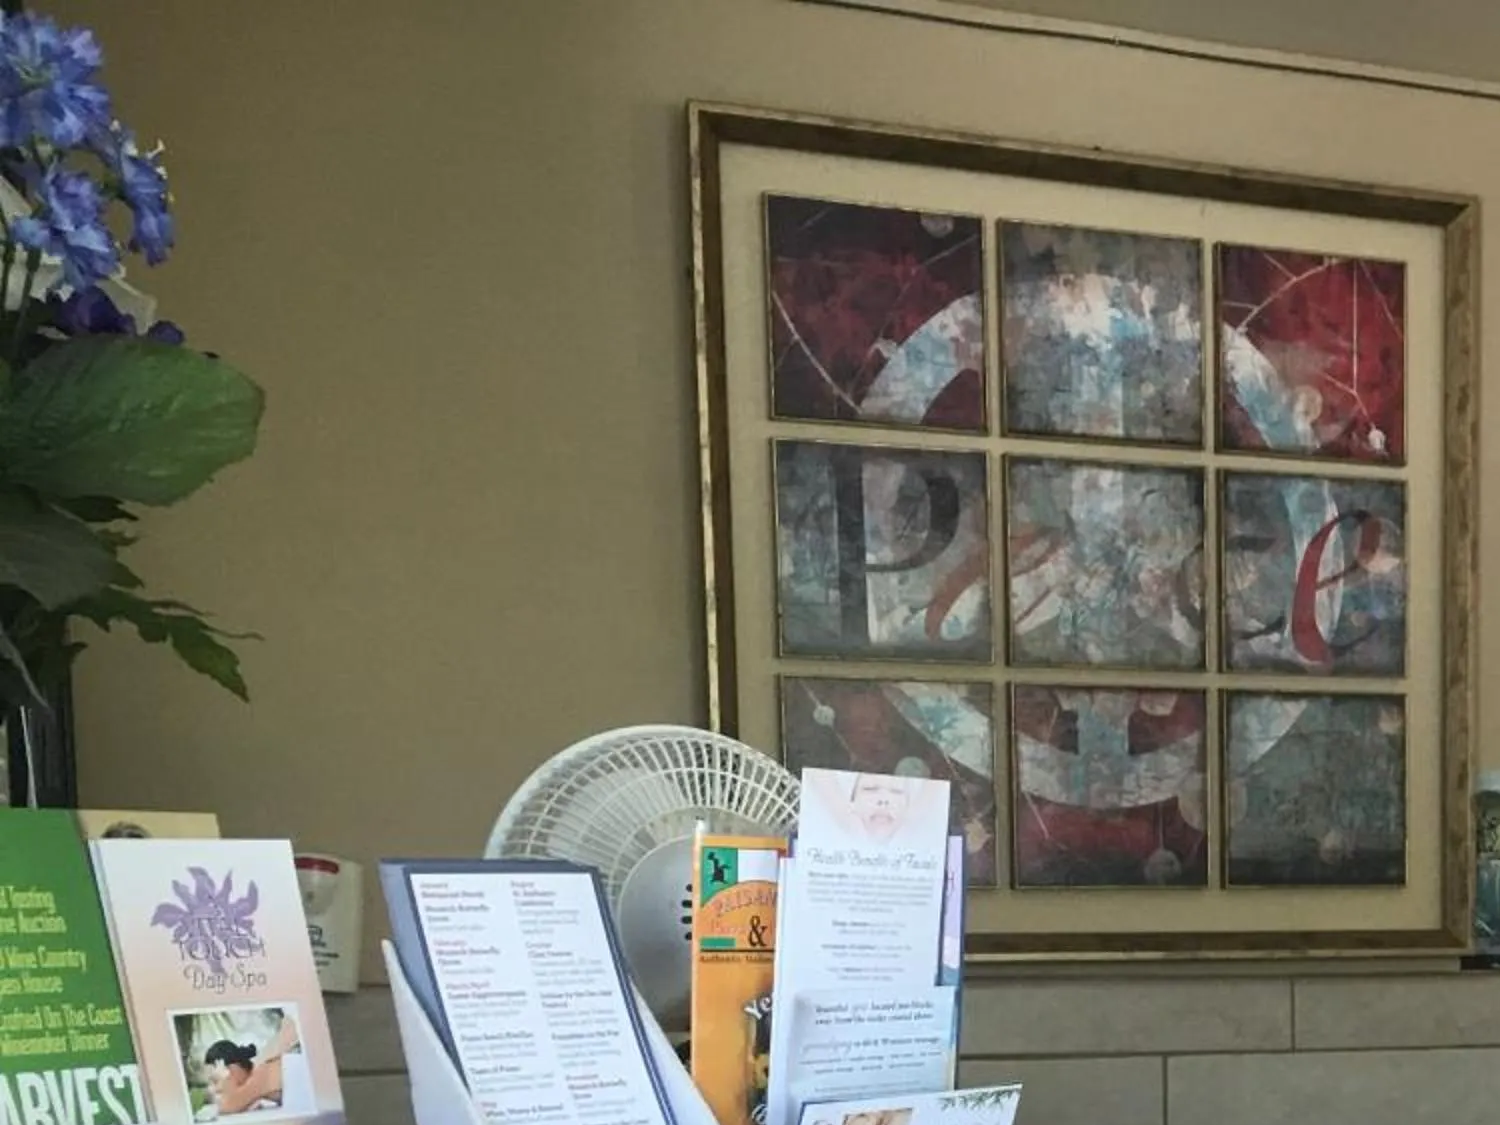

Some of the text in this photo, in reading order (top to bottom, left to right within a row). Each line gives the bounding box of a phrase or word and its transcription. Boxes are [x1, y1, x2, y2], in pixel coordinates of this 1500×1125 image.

[748, 915, 768, 948] &
[183, 961, 268, 995] Day Spa
